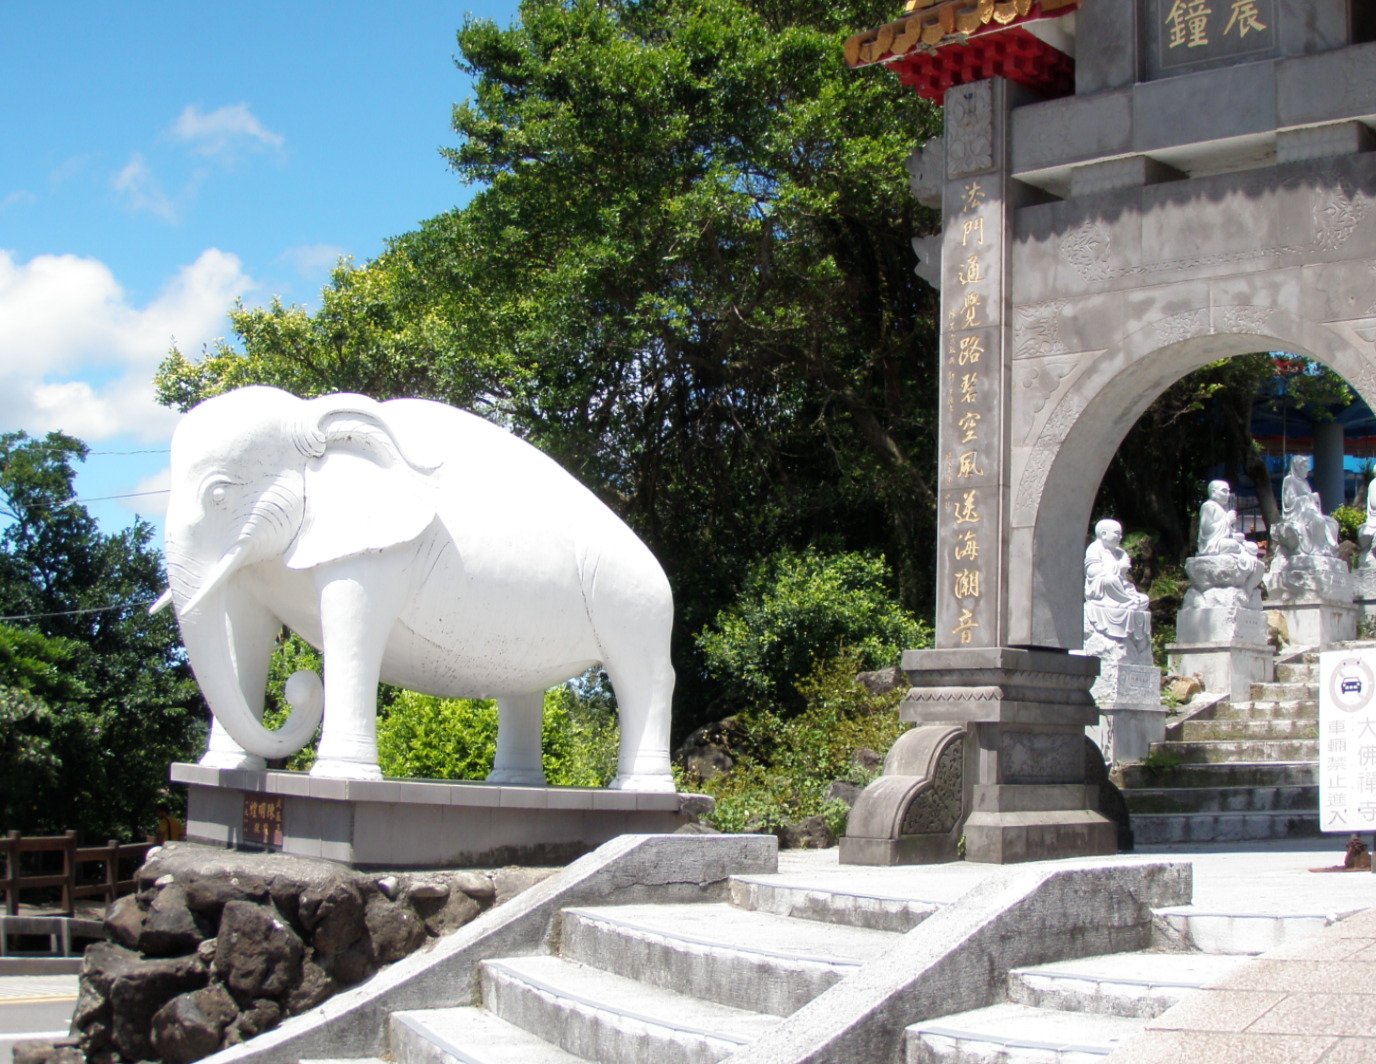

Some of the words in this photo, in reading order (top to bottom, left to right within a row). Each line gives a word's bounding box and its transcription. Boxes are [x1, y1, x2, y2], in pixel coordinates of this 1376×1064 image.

[1327, 720, 1347, 825] 車輛禁止進入
